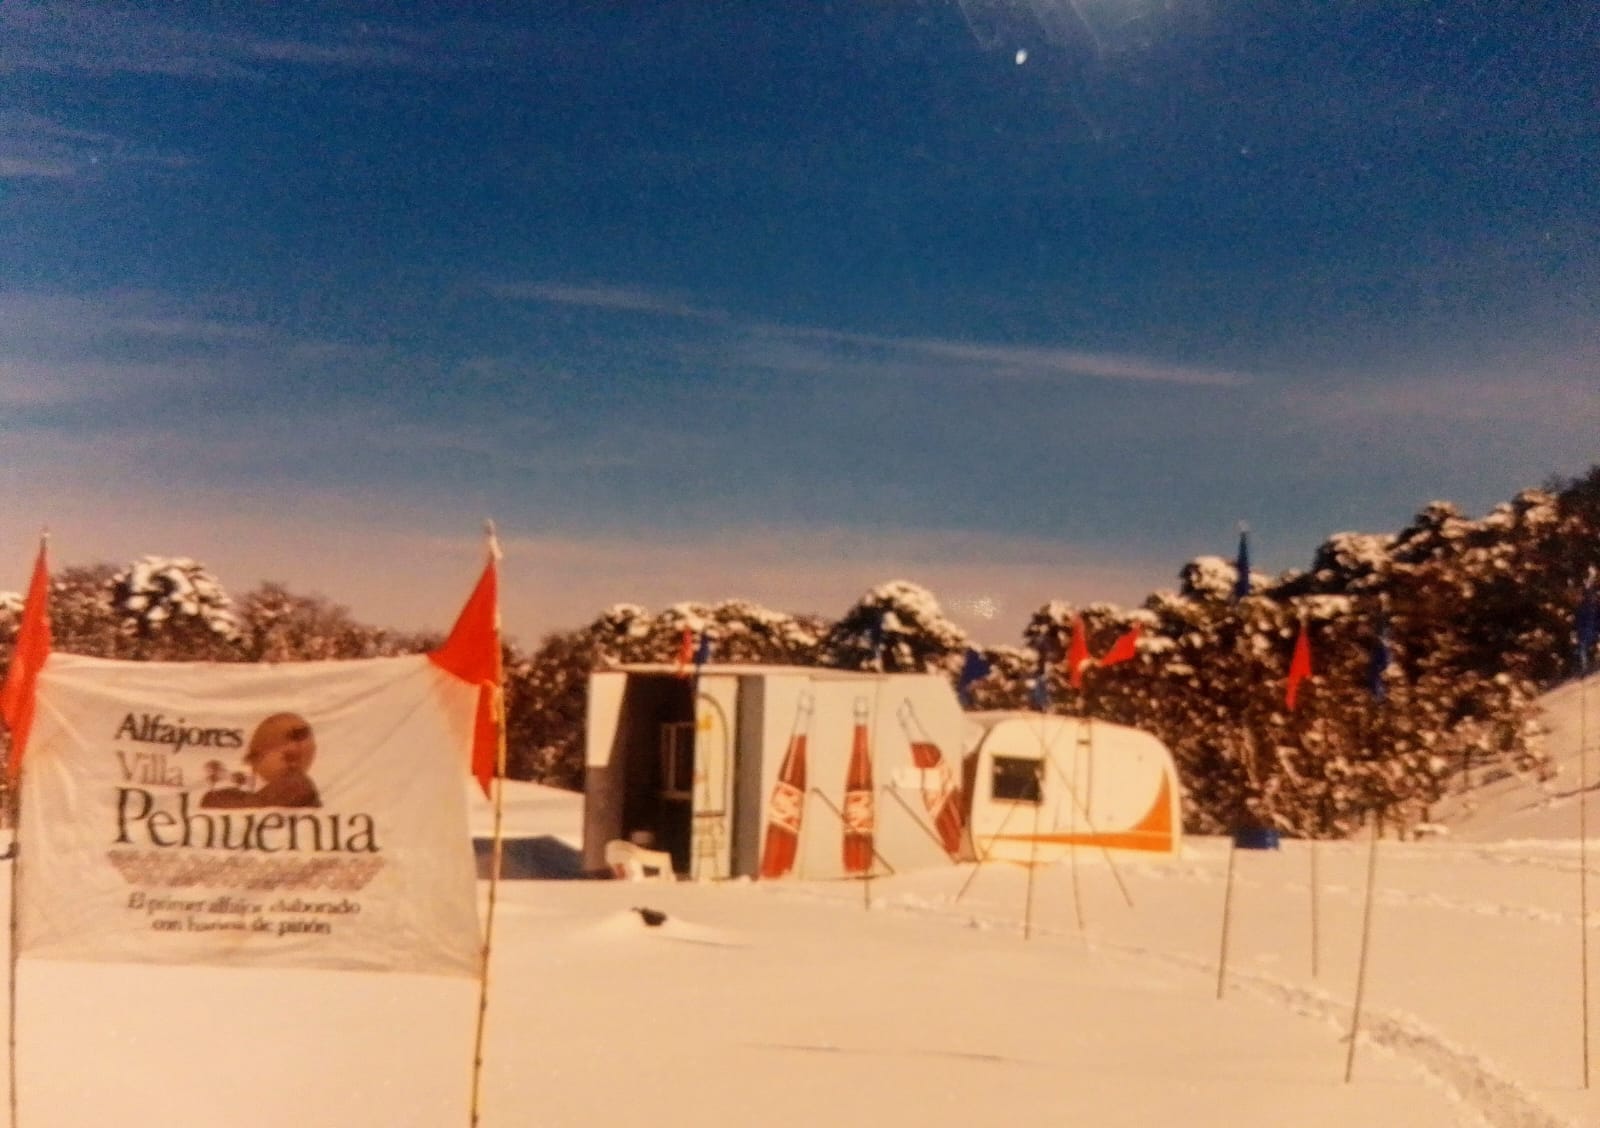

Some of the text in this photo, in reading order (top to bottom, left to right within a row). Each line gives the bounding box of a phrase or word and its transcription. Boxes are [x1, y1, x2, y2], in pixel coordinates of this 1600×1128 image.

[114, 711, 244, 751] Alfajores
[116, 751, 184, 786] Villa
[113, 786, 380, 852] Pehuenia
